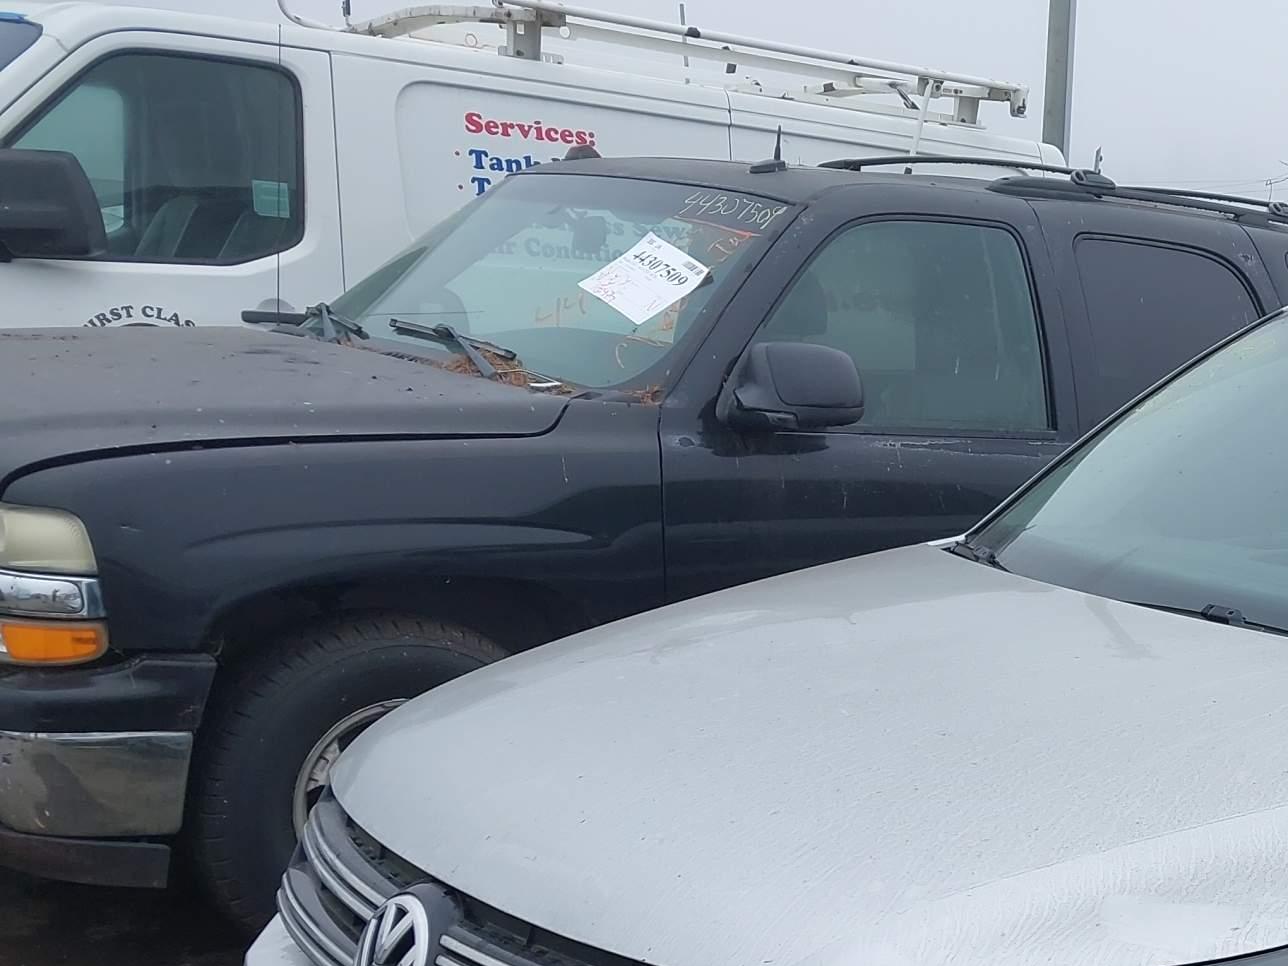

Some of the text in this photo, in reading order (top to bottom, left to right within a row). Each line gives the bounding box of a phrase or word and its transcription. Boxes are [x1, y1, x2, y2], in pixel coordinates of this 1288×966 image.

[464, 112, 596, 147] Services:
[632, 251, 690, 287] 44307509
[83, 305, 134, 328] IRST
